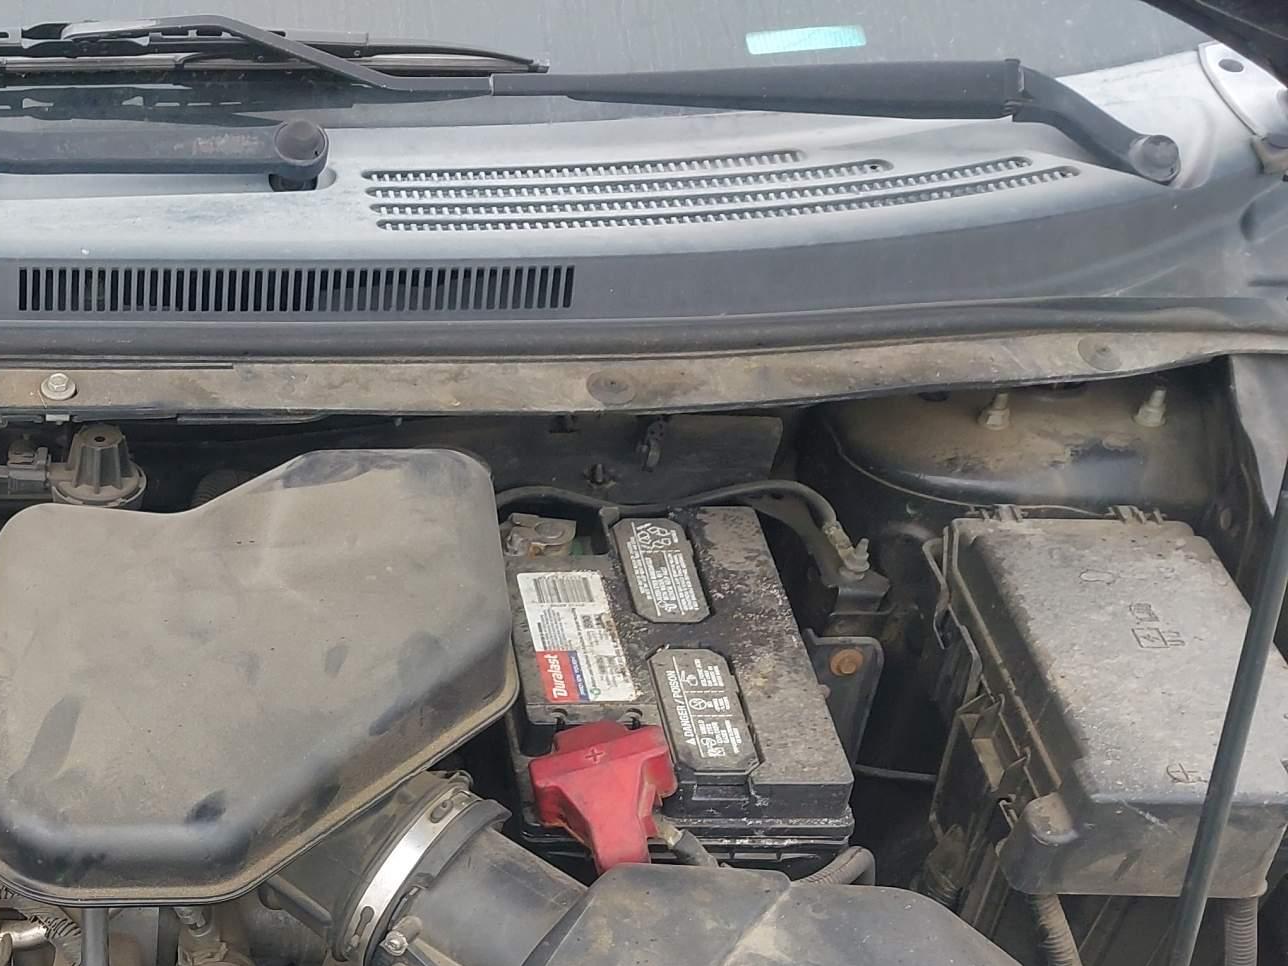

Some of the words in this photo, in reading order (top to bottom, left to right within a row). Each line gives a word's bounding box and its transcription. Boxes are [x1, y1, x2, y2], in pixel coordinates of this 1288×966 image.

[544, 654, 567, 698] Duralast
[665, 670, 682, 697] POISON
[676, 705, 693, 736] DANGER
